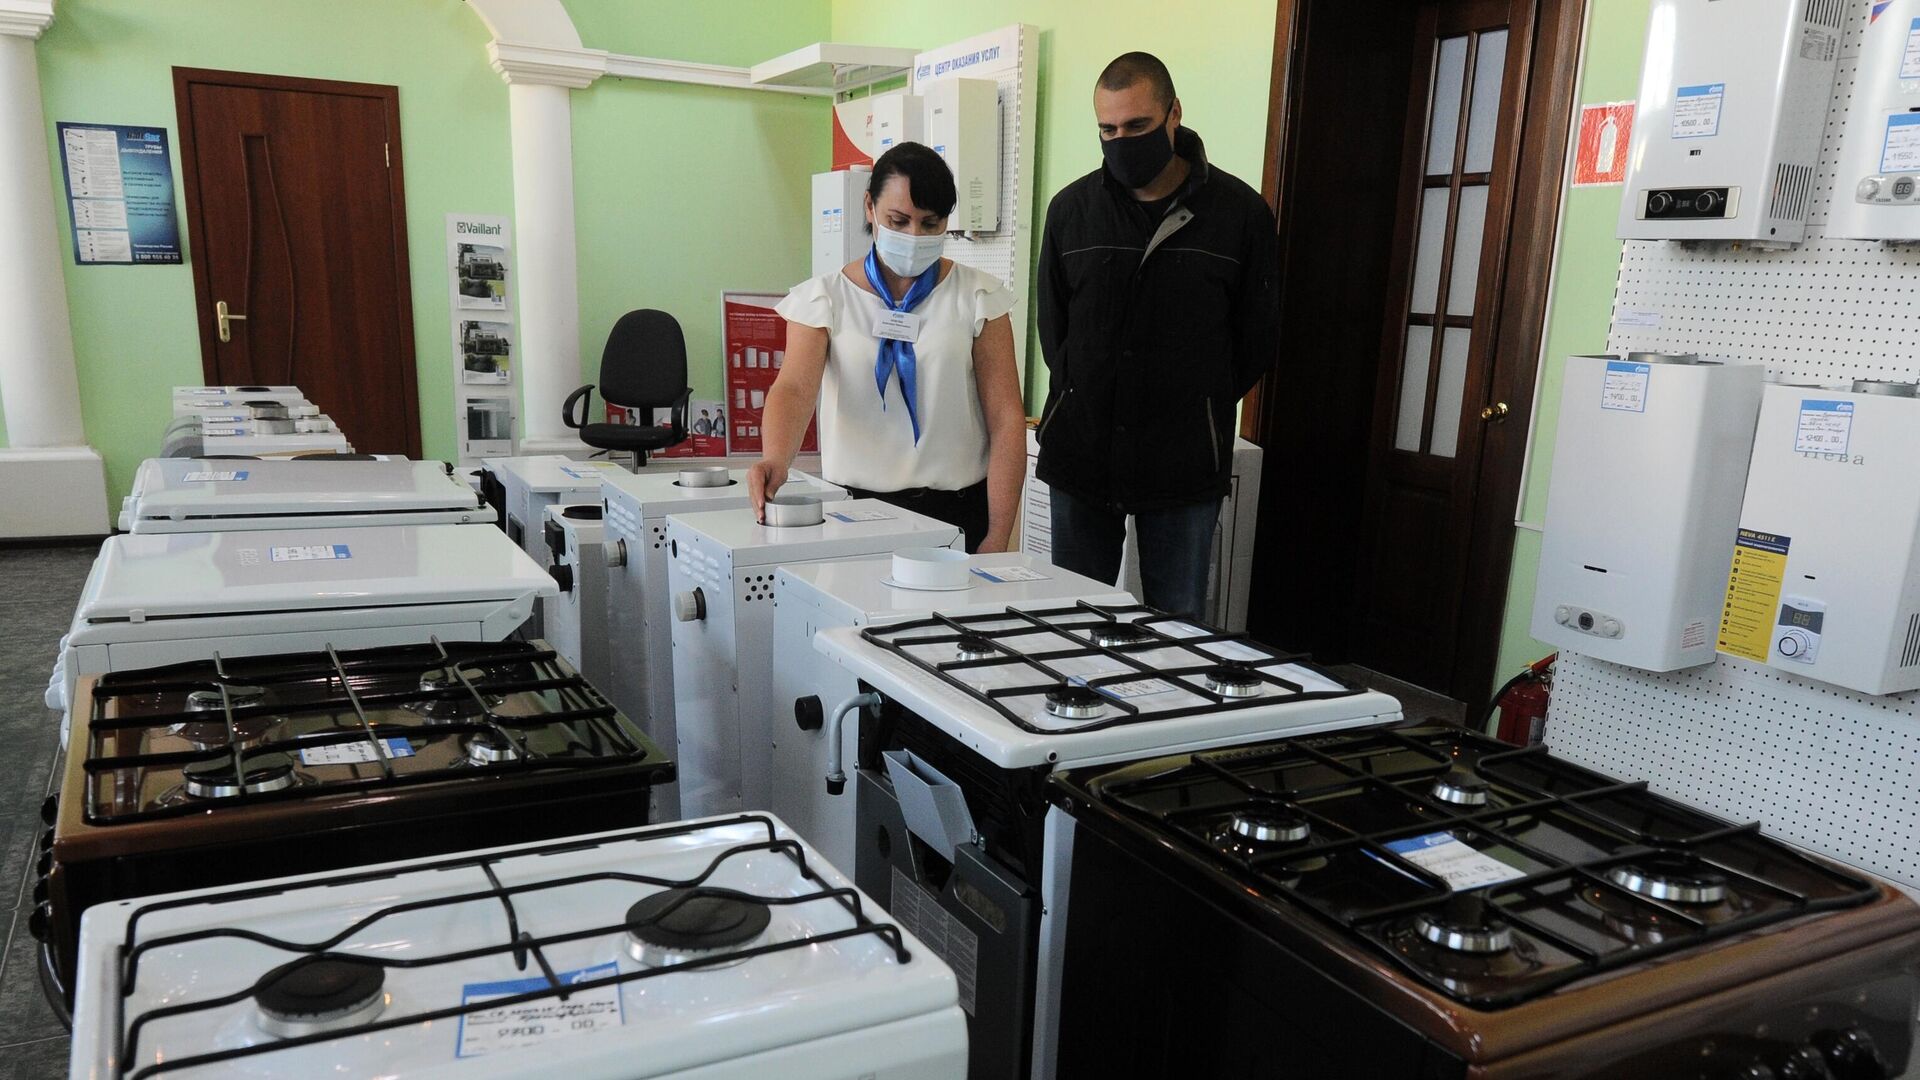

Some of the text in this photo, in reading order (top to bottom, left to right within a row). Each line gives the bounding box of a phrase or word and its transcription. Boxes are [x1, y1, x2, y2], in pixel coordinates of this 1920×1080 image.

[934, 60, 950, 77] ЦЕНТР
[952, 52, 980, 70] ОКАЗАНИЯ
[980, 46, 1000, 63] УСЛУГ
[466, 222, 502, 235] Vaillant
